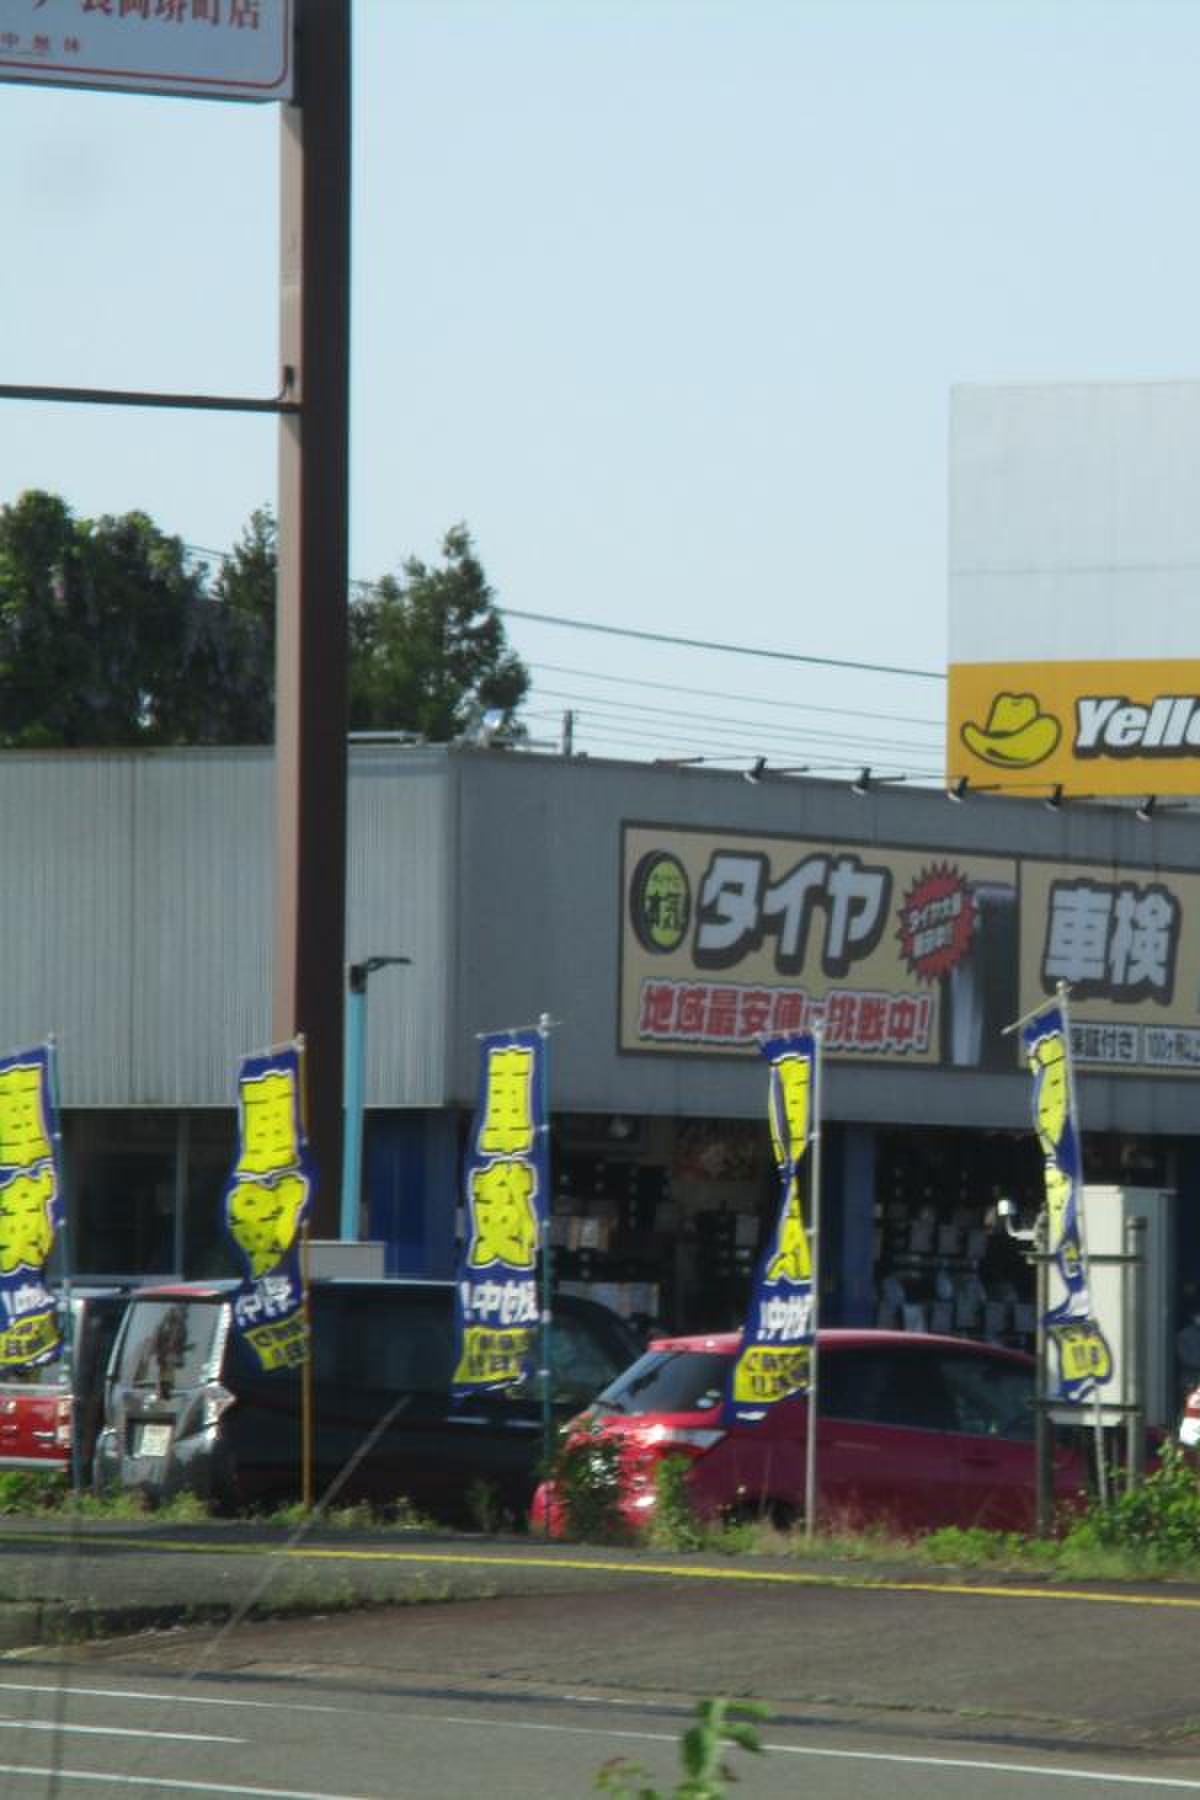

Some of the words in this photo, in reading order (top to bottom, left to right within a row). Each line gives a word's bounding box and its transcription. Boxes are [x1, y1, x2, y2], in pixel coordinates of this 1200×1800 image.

[694, 852, 890, 975] タイヤ
[1043, 880, 1180, 1004] 車検
